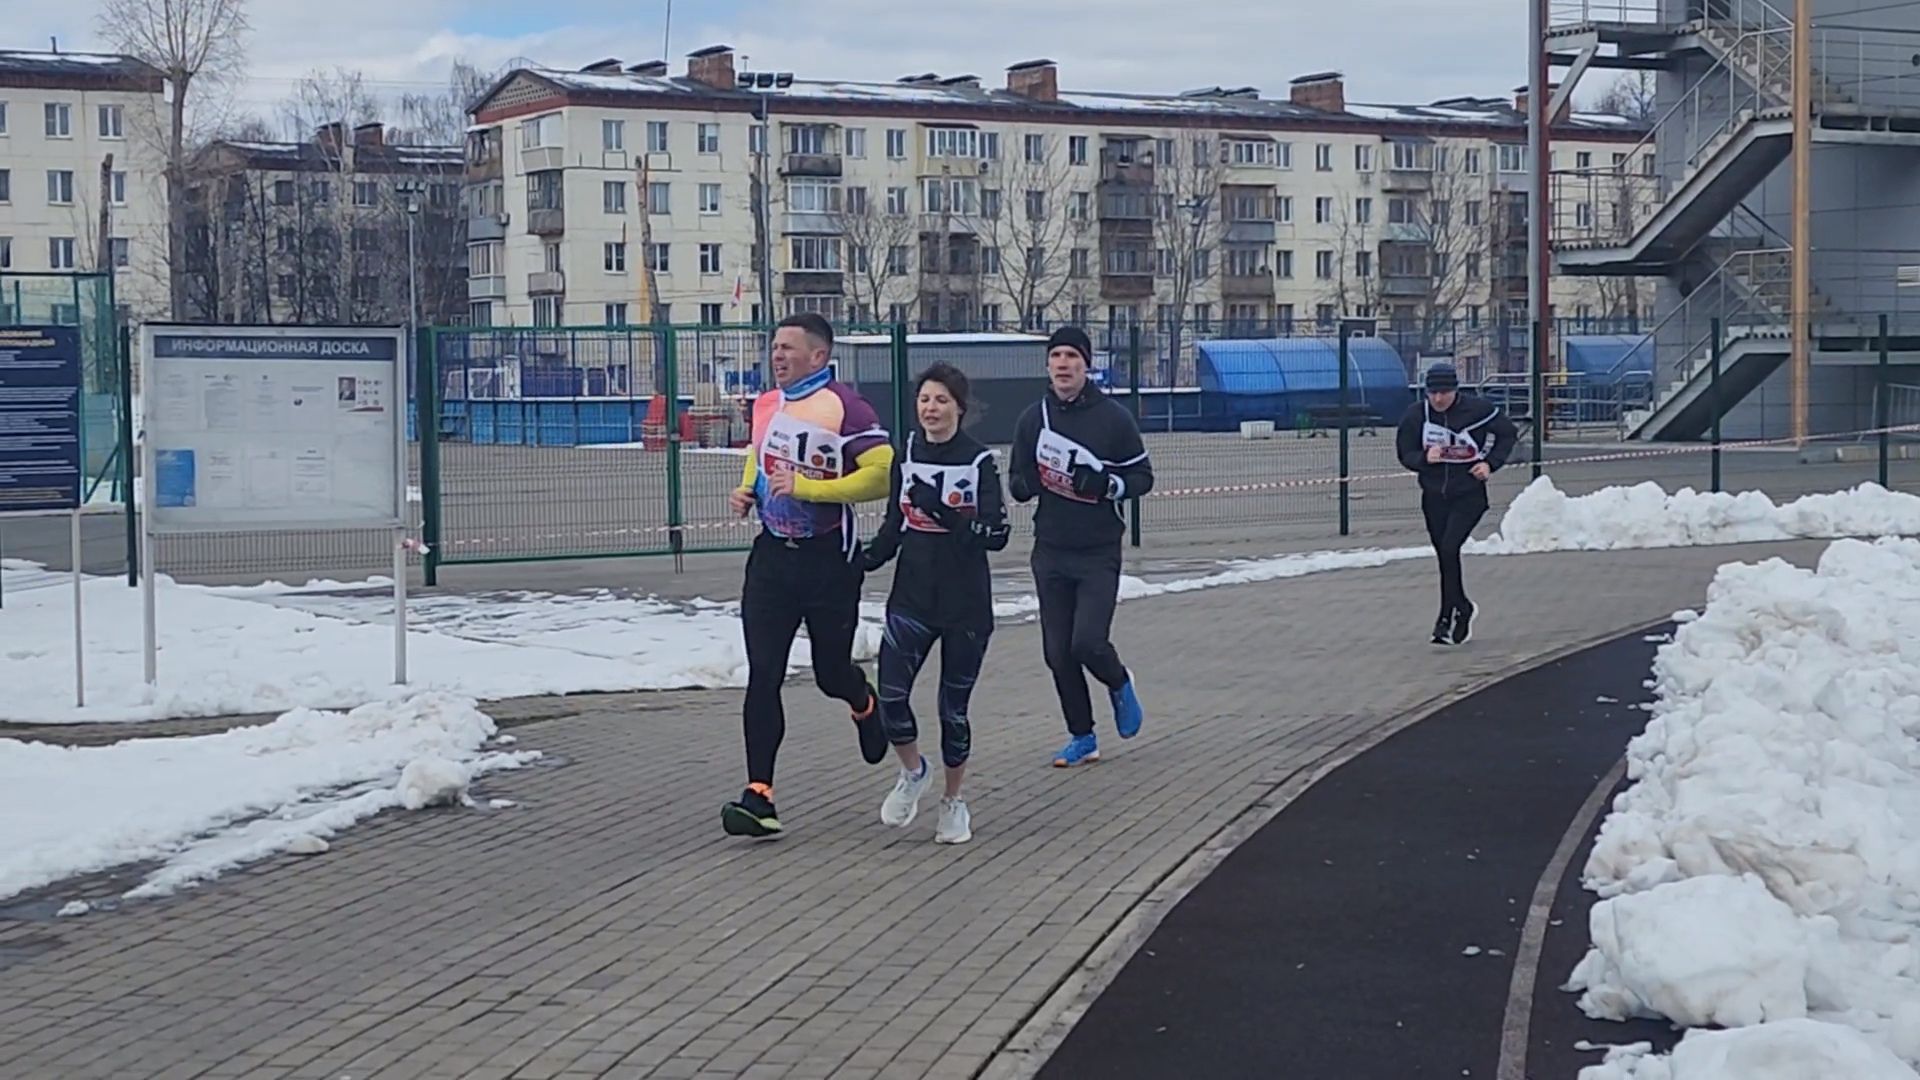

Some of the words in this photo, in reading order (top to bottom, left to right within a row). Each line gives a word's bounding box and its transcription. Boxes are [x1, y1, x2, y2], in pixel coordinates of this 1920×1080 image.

[171, 339, 318, 355] ИНФОРМАЦИОННАЯ
[320, 341, 370, 356] ДОСКА
[795, 431, 809, 463] 1
[1066, 449, 1079, 474] 1
